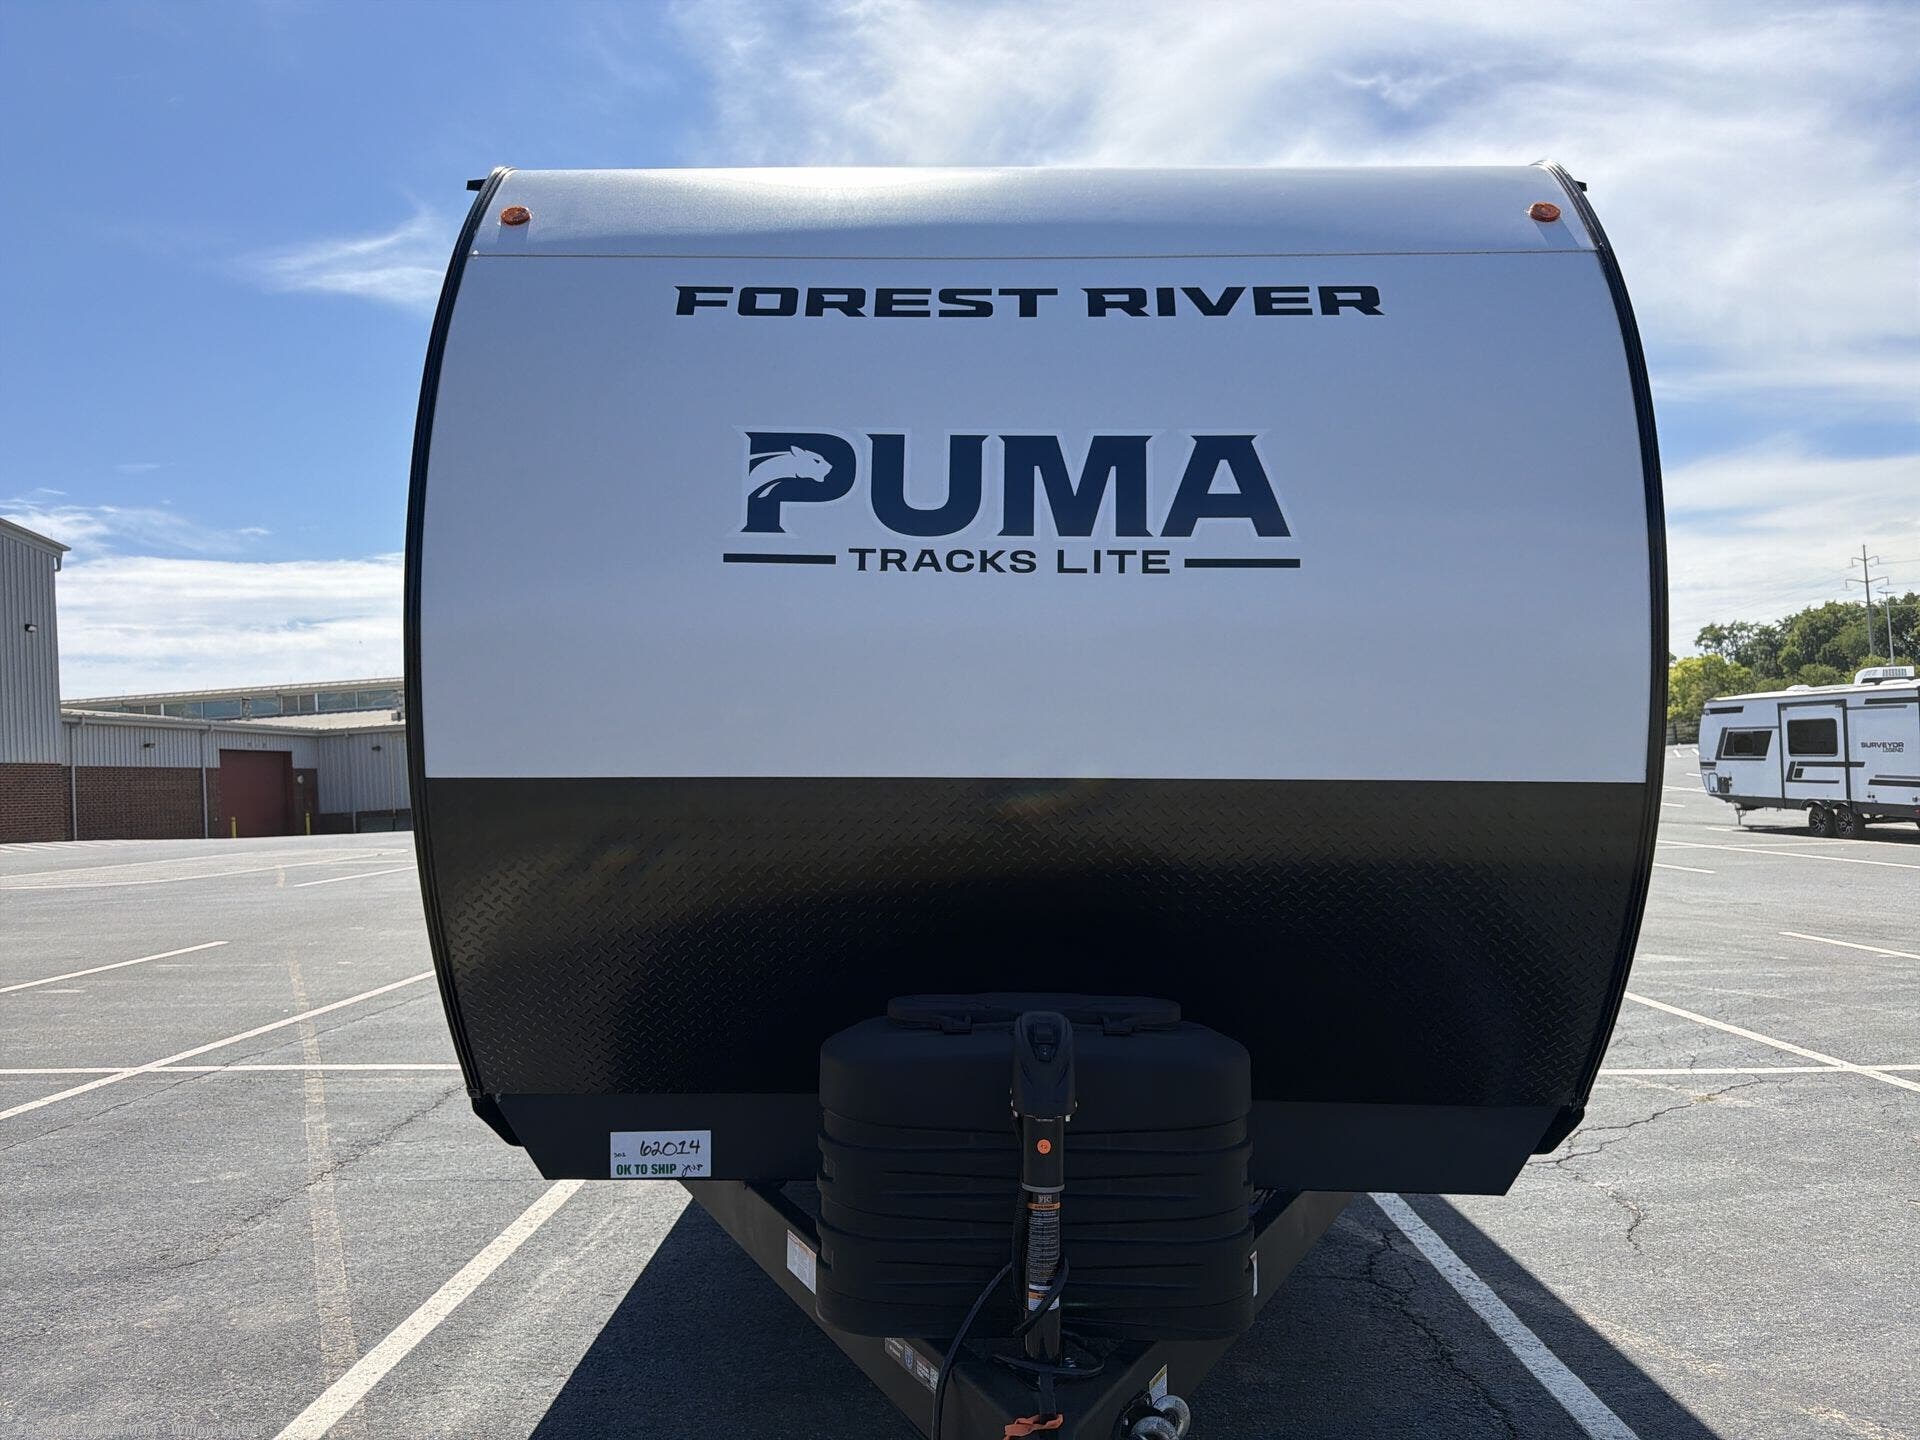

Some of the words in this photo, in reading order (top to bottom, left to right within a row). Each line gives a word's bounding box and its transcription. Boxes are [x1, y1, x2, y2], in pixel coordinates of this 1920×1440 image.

[674, 285, 1058, 318] FOREST
[1080, 285, 1386, 317] RIVER
[739, 431, 1292, 538] PUMA
[848, 548, 1038, 574] TRACKS
[1057, 549, 1171, 575] LITE
[639, 1139, 700, 1157] 62014
[616, 1164, 632, 1175] OK
[634, 1164, 648, 1175] TO
[651, 1163, 677, 1175] SHIP
